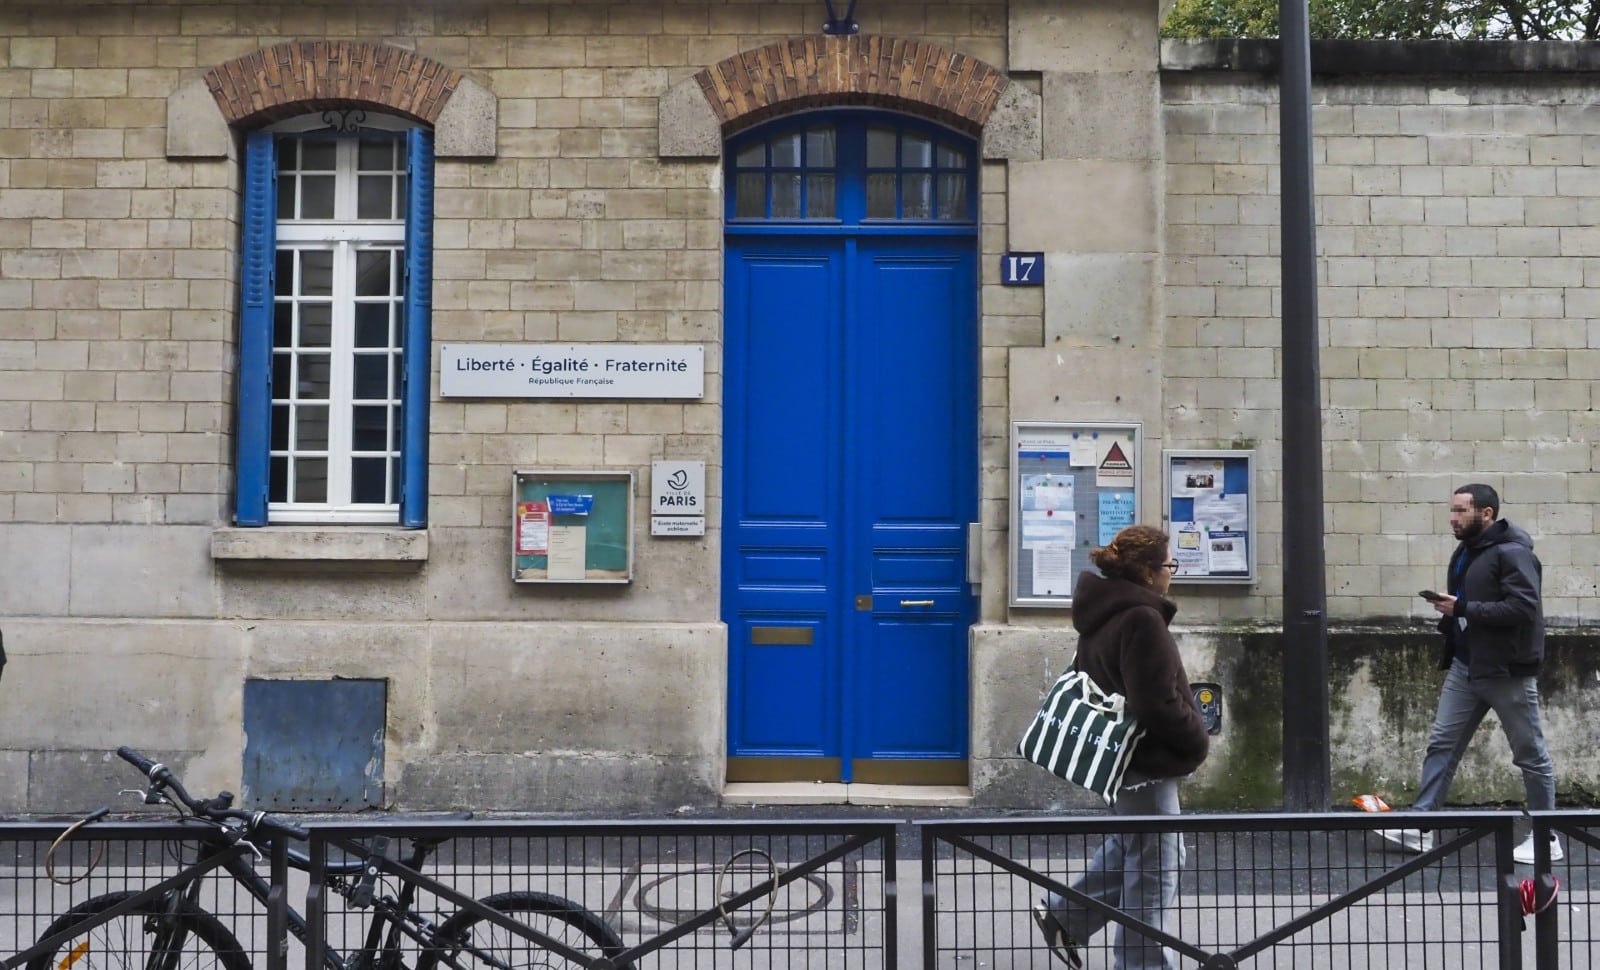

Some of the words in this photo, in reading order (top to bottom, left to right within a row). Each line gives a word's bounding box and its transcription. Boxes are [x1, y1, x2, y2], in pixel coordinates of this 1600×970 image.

[1009, 257, 1036, 281] 17
[456, 358, 515, 372] Liberté
[531, 356, 589, 375] Égalité
[605, 358, 688, 372] Fraternité
[528, 377, 575, 386] République
[576, 377, 614, 386] Française
[660, 496, 696, 506] PARIS
